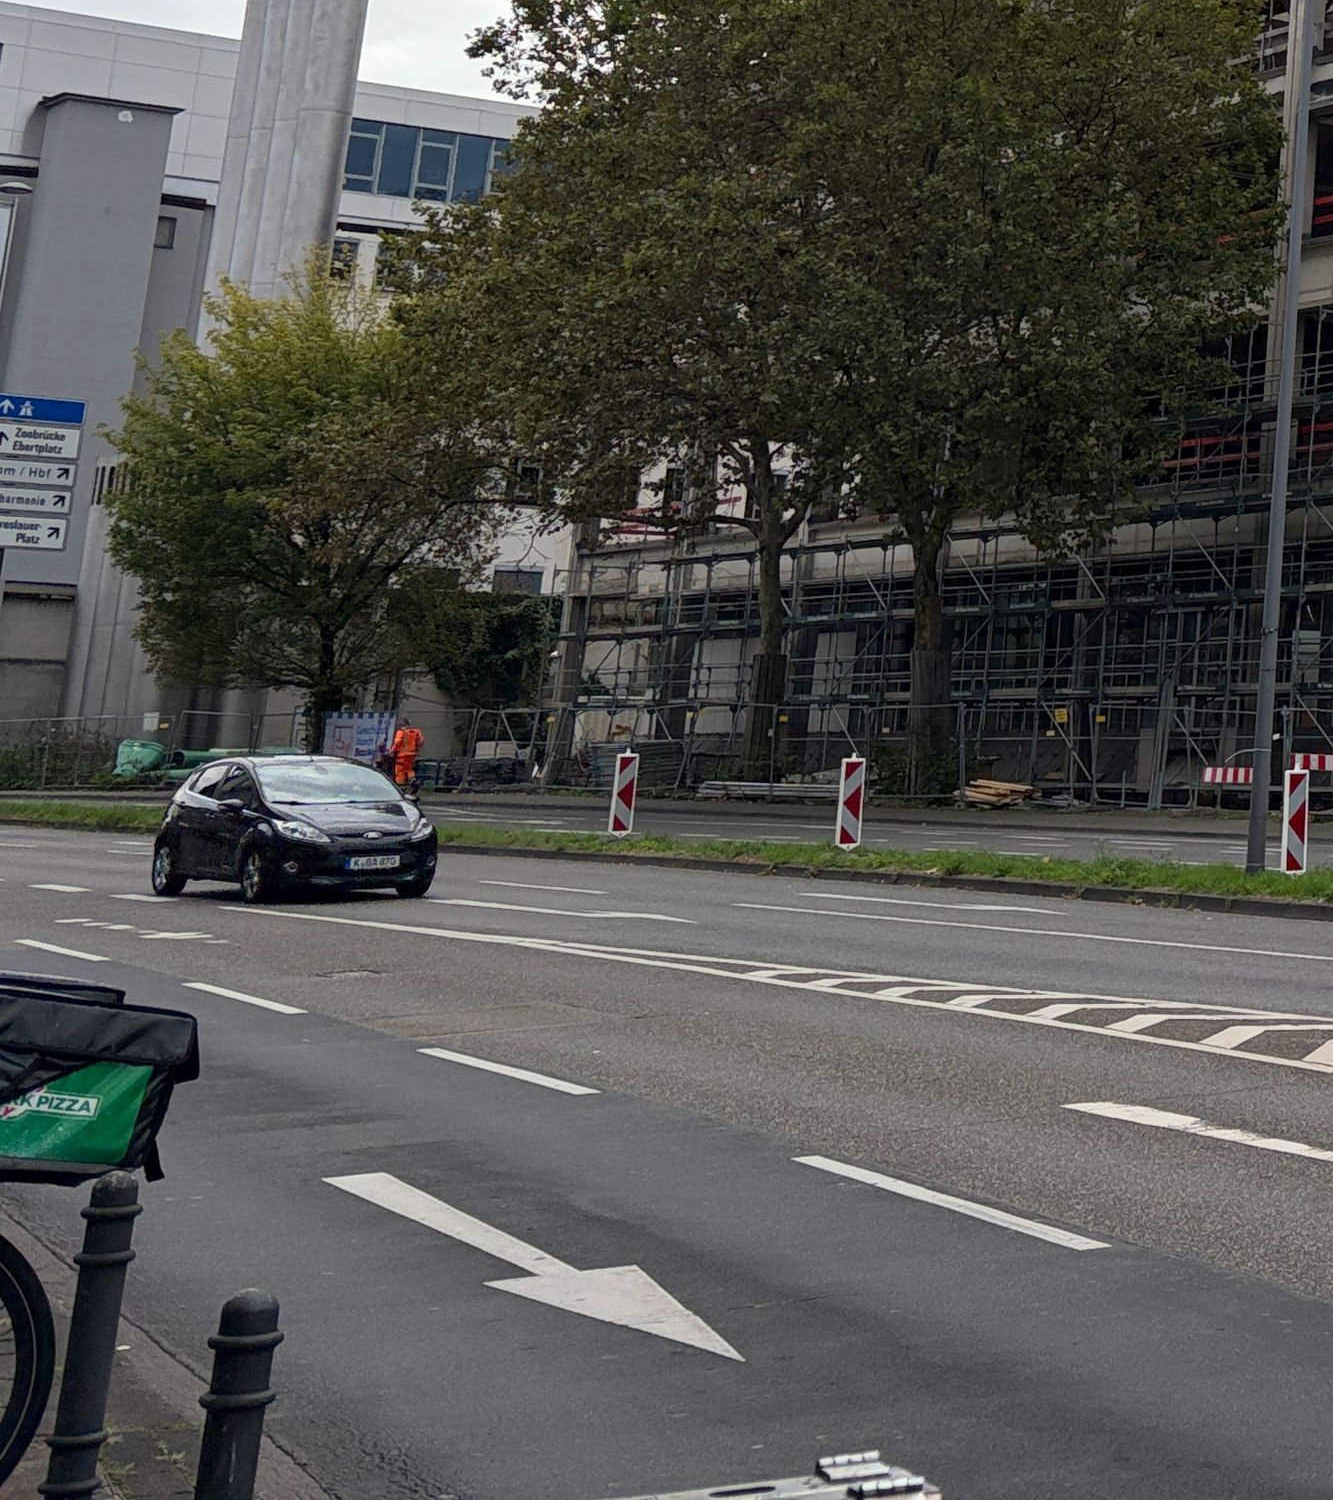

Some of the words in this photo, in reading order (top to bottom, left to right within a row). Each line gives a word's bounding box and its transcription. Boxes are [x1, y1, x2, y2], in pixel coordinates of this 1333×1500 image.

[14, 427, 66, 441] Zoobrücke
[13, 440, 63, 454] Ebertplatz
[29, 467, 52, 479] Hbf
[15, 532, 41, 544] Platz
[36, 1095, 91, 1113] PIZZA
